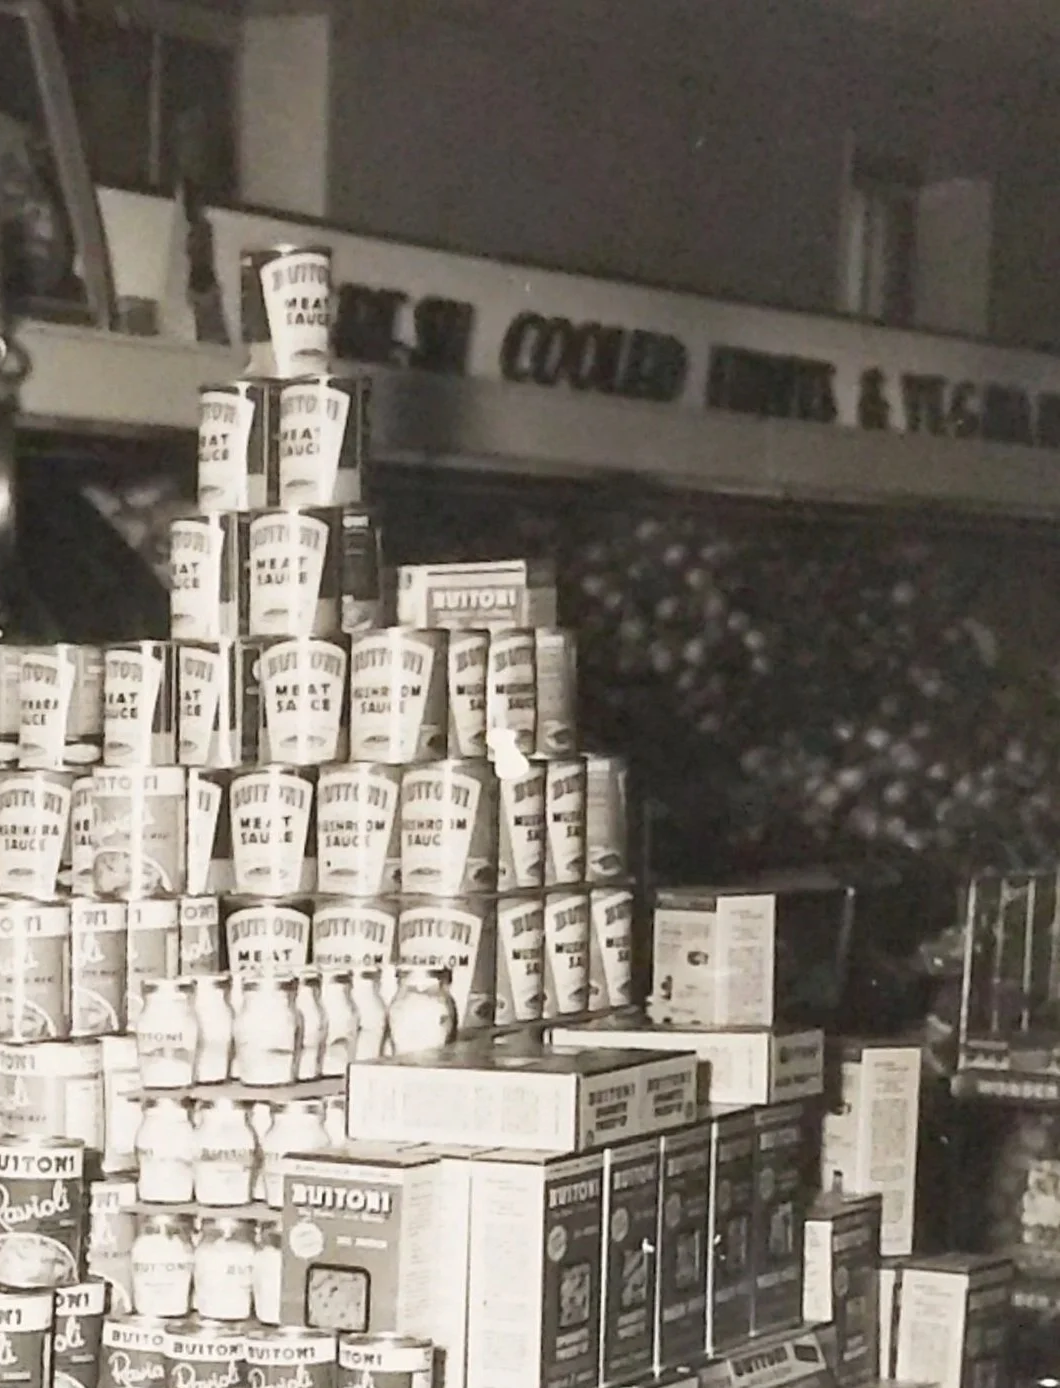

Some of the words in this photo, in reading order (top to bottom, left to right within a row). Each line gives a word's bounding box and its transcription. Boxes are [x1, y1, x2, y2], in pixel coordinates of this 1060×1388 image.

[257, 571, 308, 586] SAUE
[275, 682, 331, 697] MEAT
[276, 698, 331, 713] SACE
[240, 815, 292, 830] MET
[240, 830, 293, 846] SAUE
[407, 833, 442, 847] SAUC
[292, 1183, 392, 1213] BUITONI
[549, 1178, 600, 1208] BUITONI
[111, 1329, 164, 1346] BUITO
[343, 1349, 383, 1366] TONI
[108, 1351, 165, 1388] Ravio
